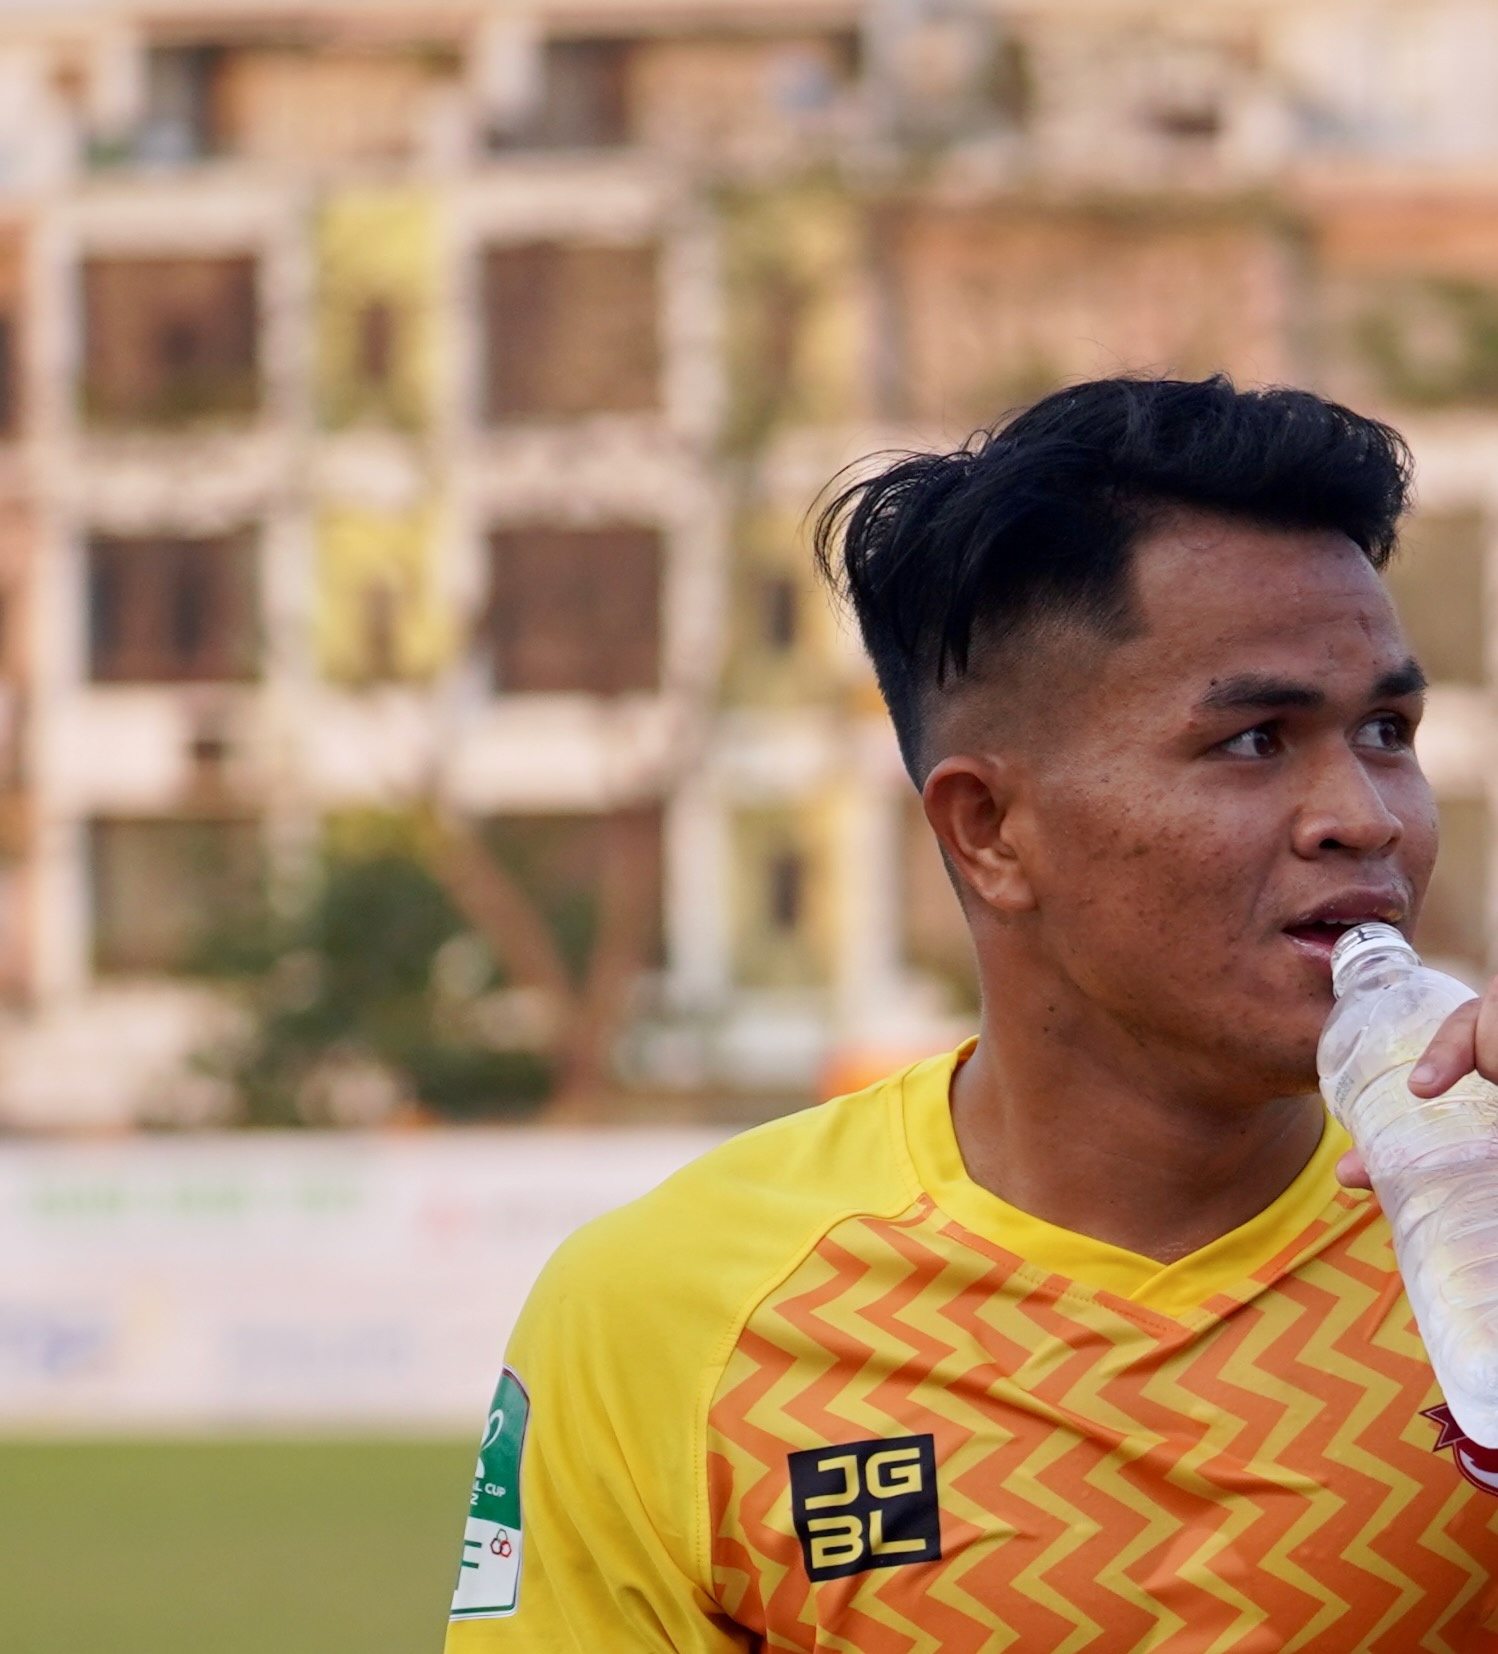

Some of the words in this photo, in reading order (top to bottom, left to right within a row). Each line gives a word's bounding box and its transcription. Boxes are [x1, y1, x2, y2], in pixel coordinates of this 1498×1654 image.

[484, 1481, 507, 1498] CUP
[805, 1446, 923, 1511] JG
[807, 1509, 927, 1570] BL
